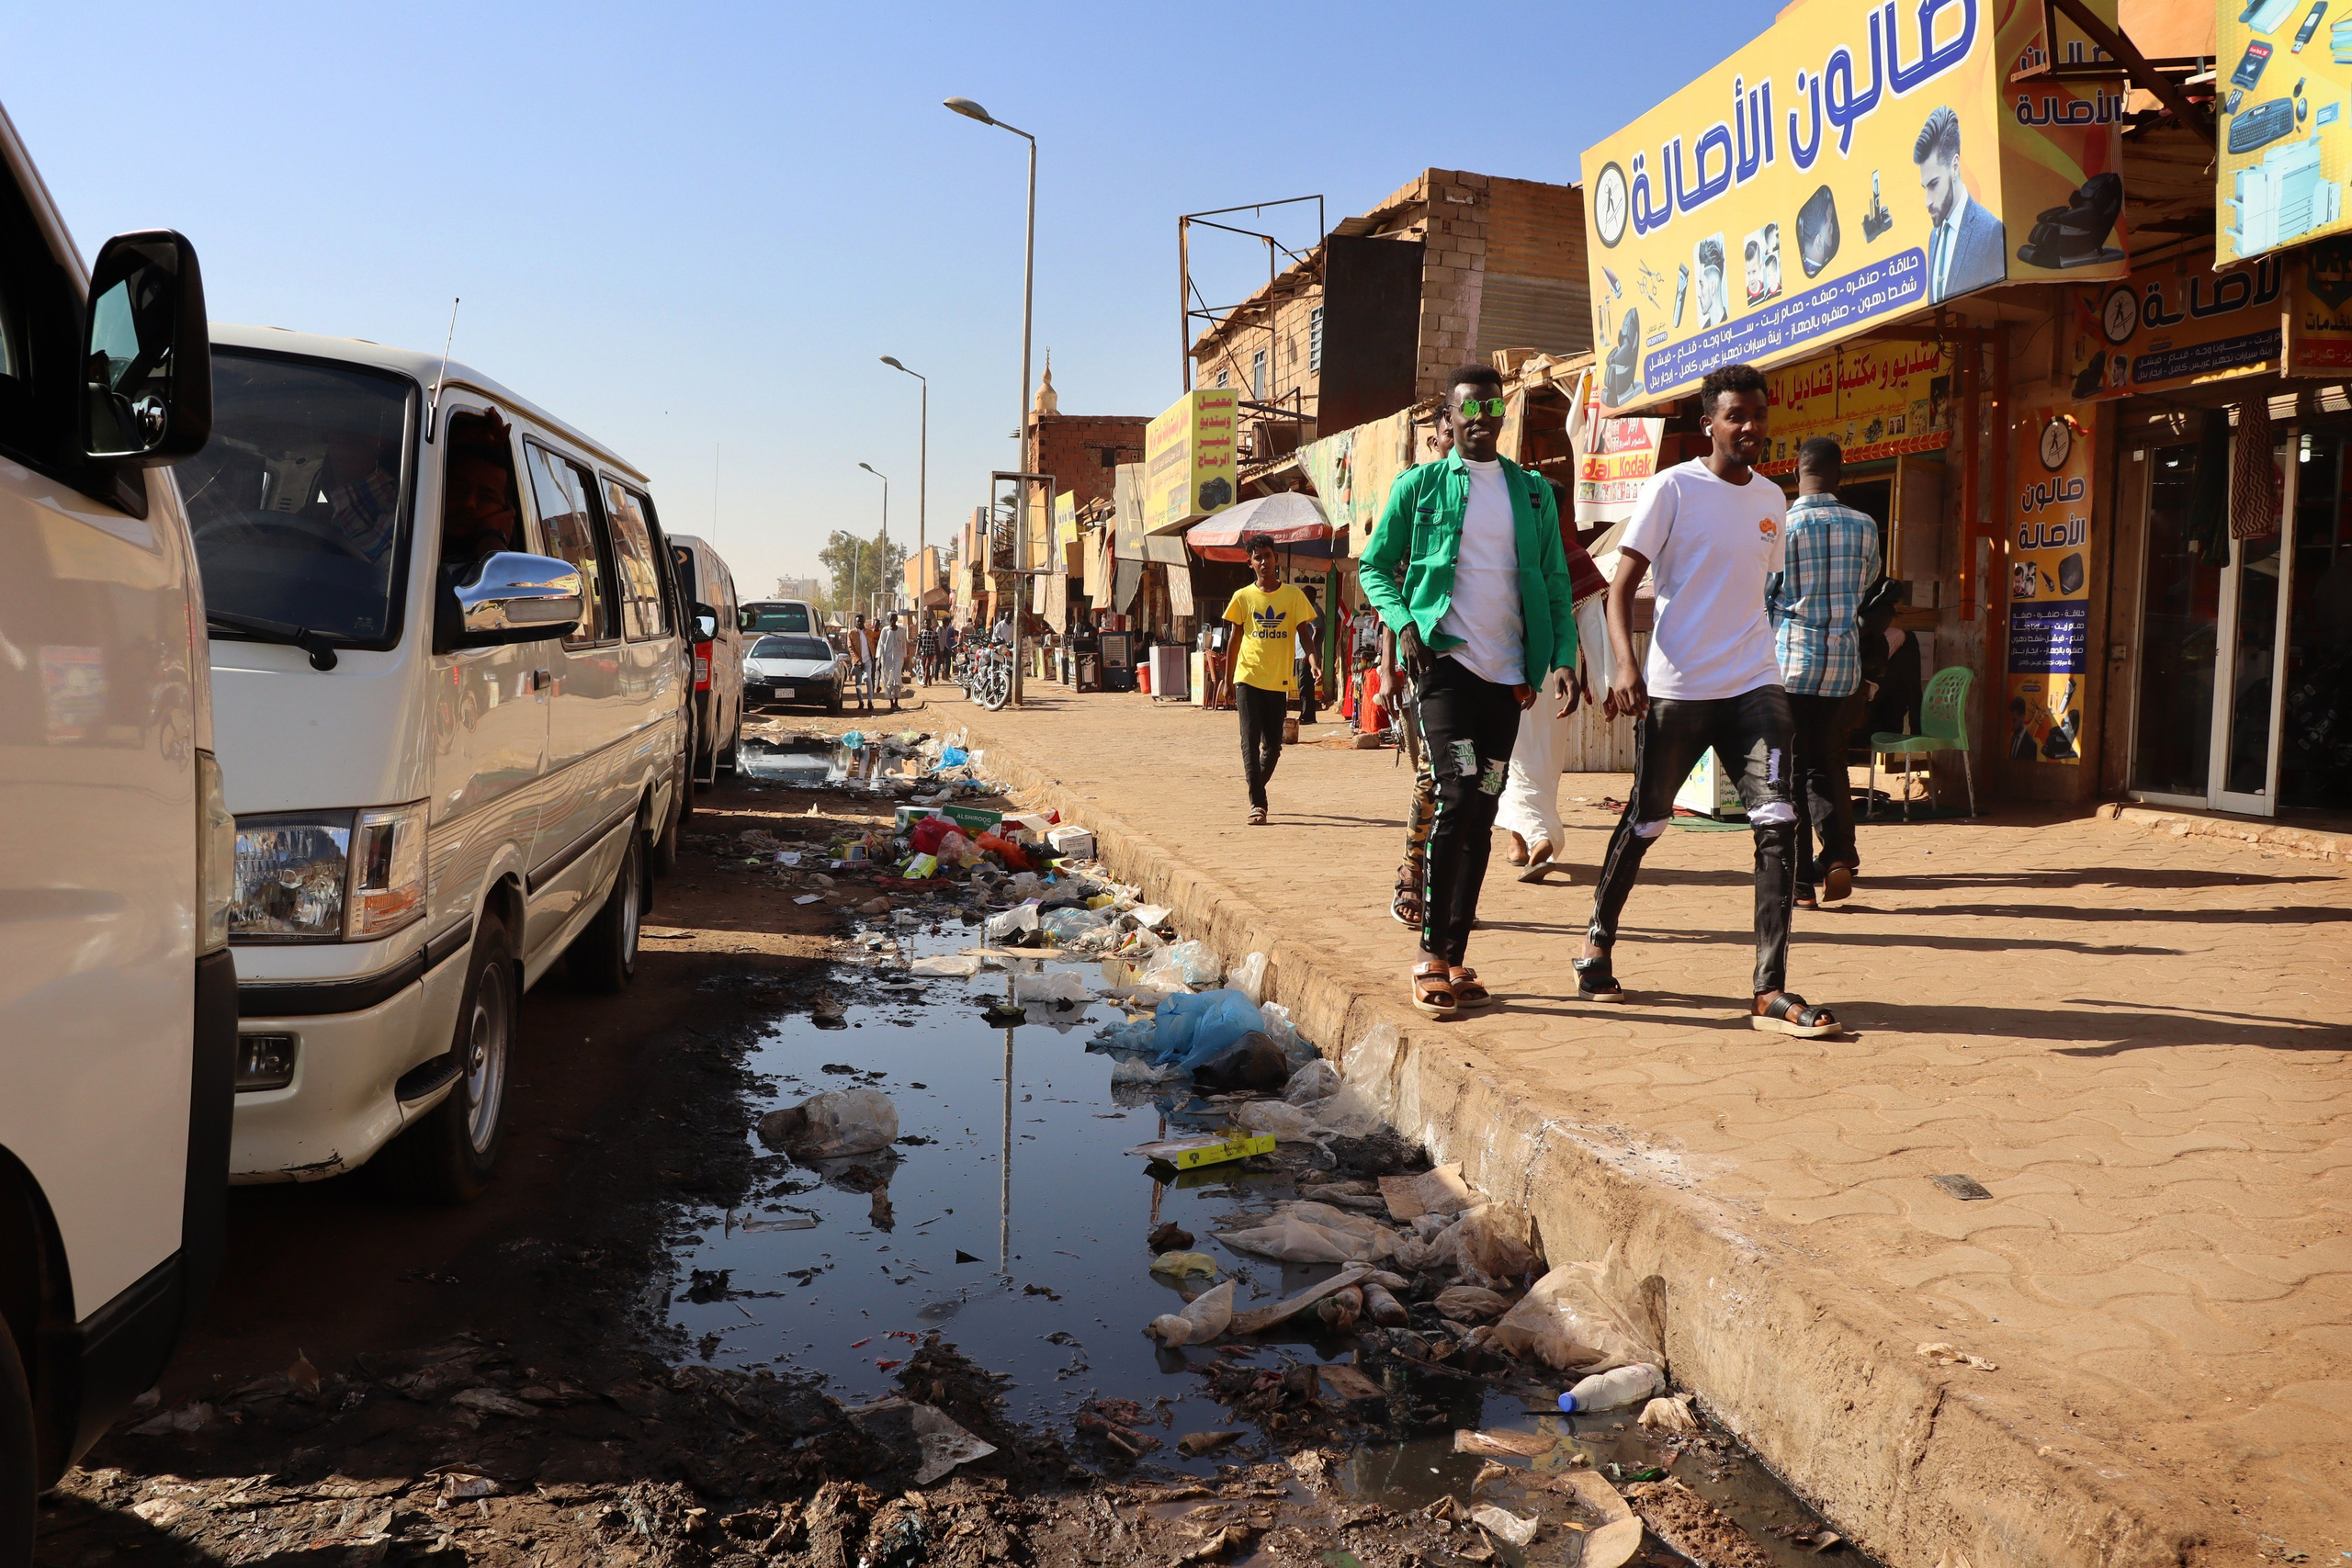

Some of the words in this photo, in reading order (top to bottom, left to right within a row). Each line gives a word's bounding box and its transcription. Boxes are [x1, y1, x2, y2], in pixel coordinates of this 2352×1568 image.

[1790, 0, 1977, 170] صالون
[2016, 88, 2122, 127] الأصالة
[1632, 78, 1774, 236] الأصالة
[1889, 255, 1919, 276] حلاقة
[1847, 271, 1879, 296] صنفره
[1888, 276, 1917, 300] شفط
[1781, 300, 1804, 322] حمام
[1858, 291, 1886, 314] دهون
[1761, 313, 1780, 326] زيت
[1822, 305, 1849, 326] صنفره
[1720, 322, 1754, 344] ساونا
[1769, 330, 1782, 345] زينة
[1791, 315, 1820, 340] بالجهاز
[1678, 341, 1697, 363] قناع
[1702, 334, 1720, 349] وجه
[1744, 337, 1767, 355] سيارات
[1649, 351, 1671, 371] فيشل
[1699, 353, 1720, 371] عريس
[1722, 344, 1743, 366] تجهيز
[1679, 361, 1698, 378] كامل
[1838, 352, 1878, 398] مكتبة
[1649, 376, 1660, 389] بدل
[1768, 377, 1784, 408] المع
[1788, 362, 1833, 412] قناديل
[1198, 395, 1233, 411] معمل
[1199, 415, 1231, 430] وستديو
[1197, 434, 1231, 448] منير
[1620, 454, 1652, 476] Kodak
[2022, 477, 2086, 513] صالون
[2018, 513, 2086, 550] الأصالة
[2064, 609, 2085, 617] حلاقة
[1252, 629, 1288, 639] adidas
[2054, 622, 2068, 631] زيت
[2069, 633, 2085, 645] قناع
